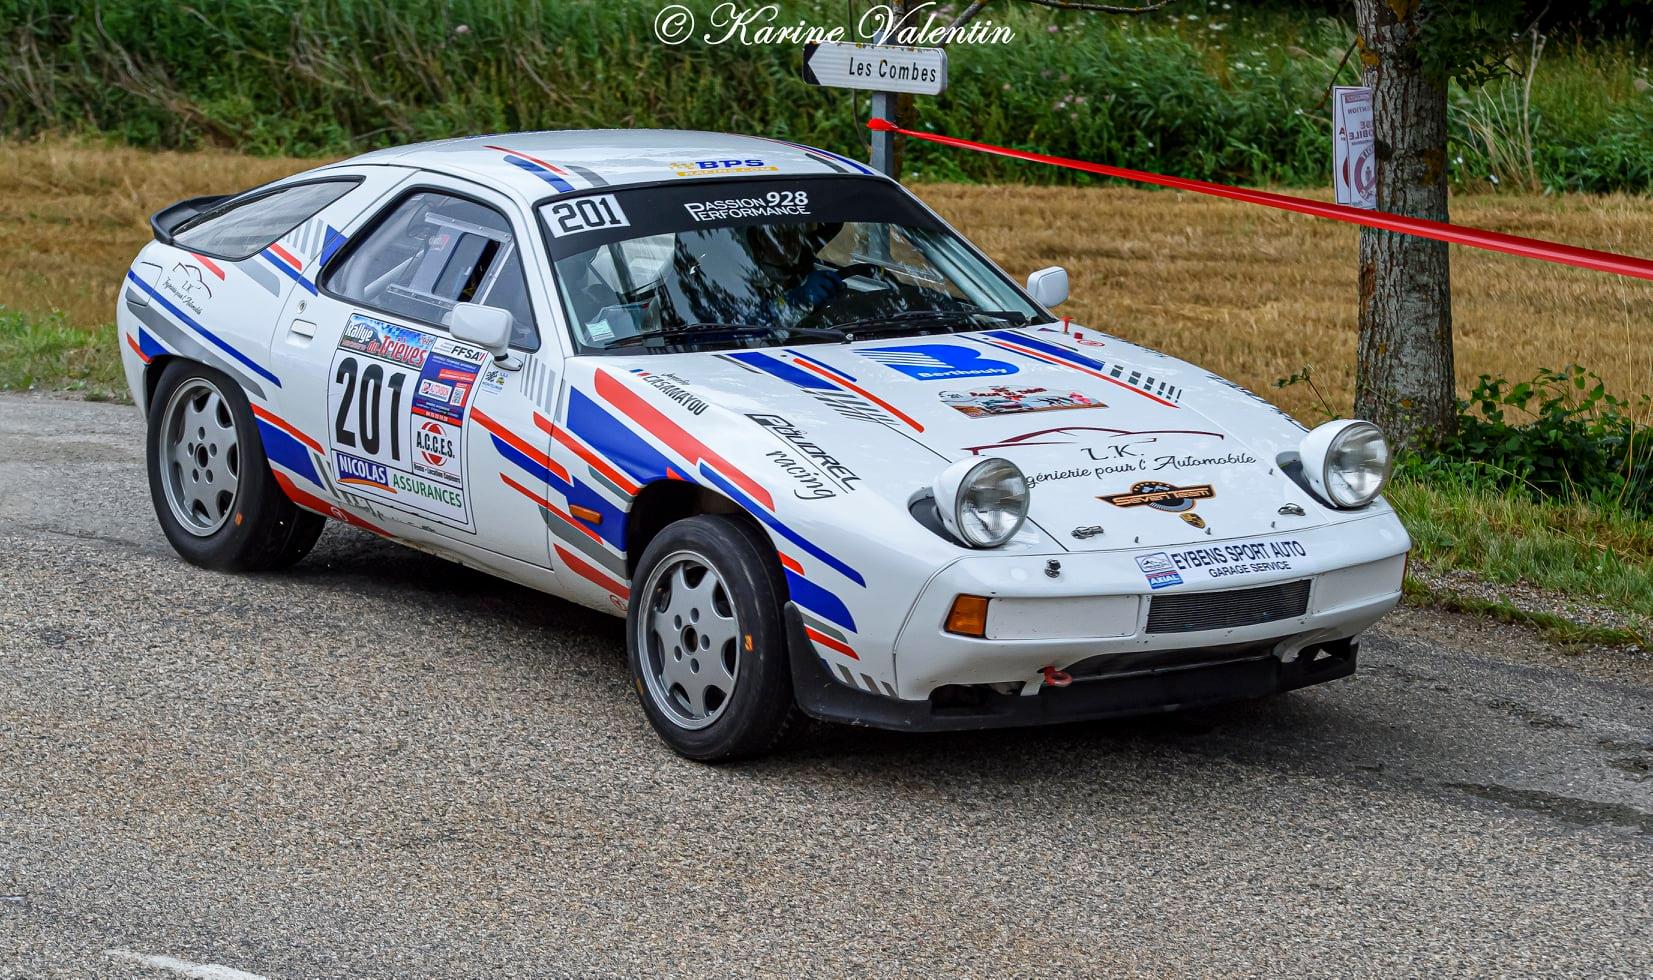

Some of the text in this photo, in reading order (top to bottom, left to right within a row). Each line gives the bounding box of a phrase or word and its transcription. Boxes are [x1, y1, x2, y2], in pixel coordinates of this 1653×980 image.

[849, 57, 936, 82] Les Combes
[695, 159, 765, 170] BPS
[552, 198, 622, 233] 201
[684, 191, 809, 222] PASSION 928
[345, 320, 373, 344] Rallye
[380, 335, 429, 366] Trièves
[451, 345, 482, 362] FFSA
[917, 366, 1008, 379] Berthouly
[335, 357, 407, 461] 201
[643, 375, 710, 416] CASAMAYOU
[416, 431, 455, 459] A.C.C.E.S.
[1080, 444, 1145, 461] L.K.
[339, 454, 387, 485] NICOLAS
[765, 451, 836, 500] racing
[1026, 467, 1092, 488] génierie
[1095, 461, 1137, 480] pour
[1153, 453, 1257, 471] Automobile
[393, 474, 462, 509] ASSURANCES
[1171, 540, 1307, 570] EYBENS SPORT AUTO
[1209, 560, 1292, 578] GARAGE SERVICE
[1150, 574, 1180, 586] AXIAL
